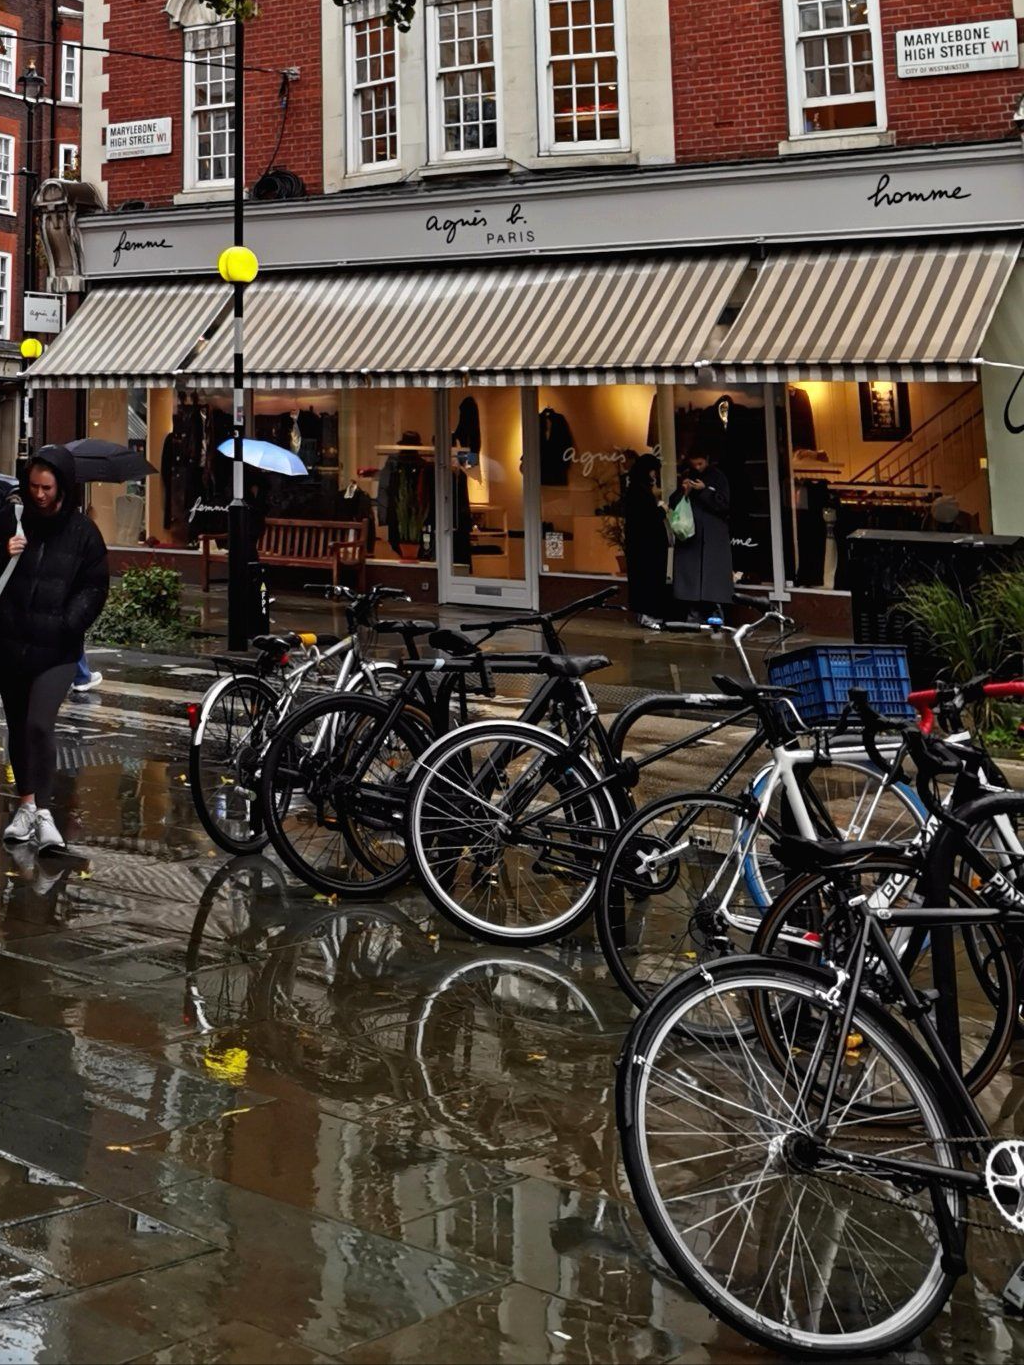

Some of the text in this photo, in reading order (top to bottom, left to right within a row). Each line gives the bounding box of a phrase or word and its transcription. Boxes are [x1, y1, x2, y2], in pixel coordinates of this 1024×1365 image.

[904, 27, 990, 47] MARYLEBONE
[905, 40, 1009, 61] HIGH STREET W1
[905, 63, 970, 75] CITY OF WESTMINSTER
[110, 123, 157, 136] MARYLEBONE
[110, 133, 167, 147] HIGH STREET W1
[867, 174, 972, 207] homme
[487, 229, 536, 245] PARIS
[113, 230, 174, 267] femme
